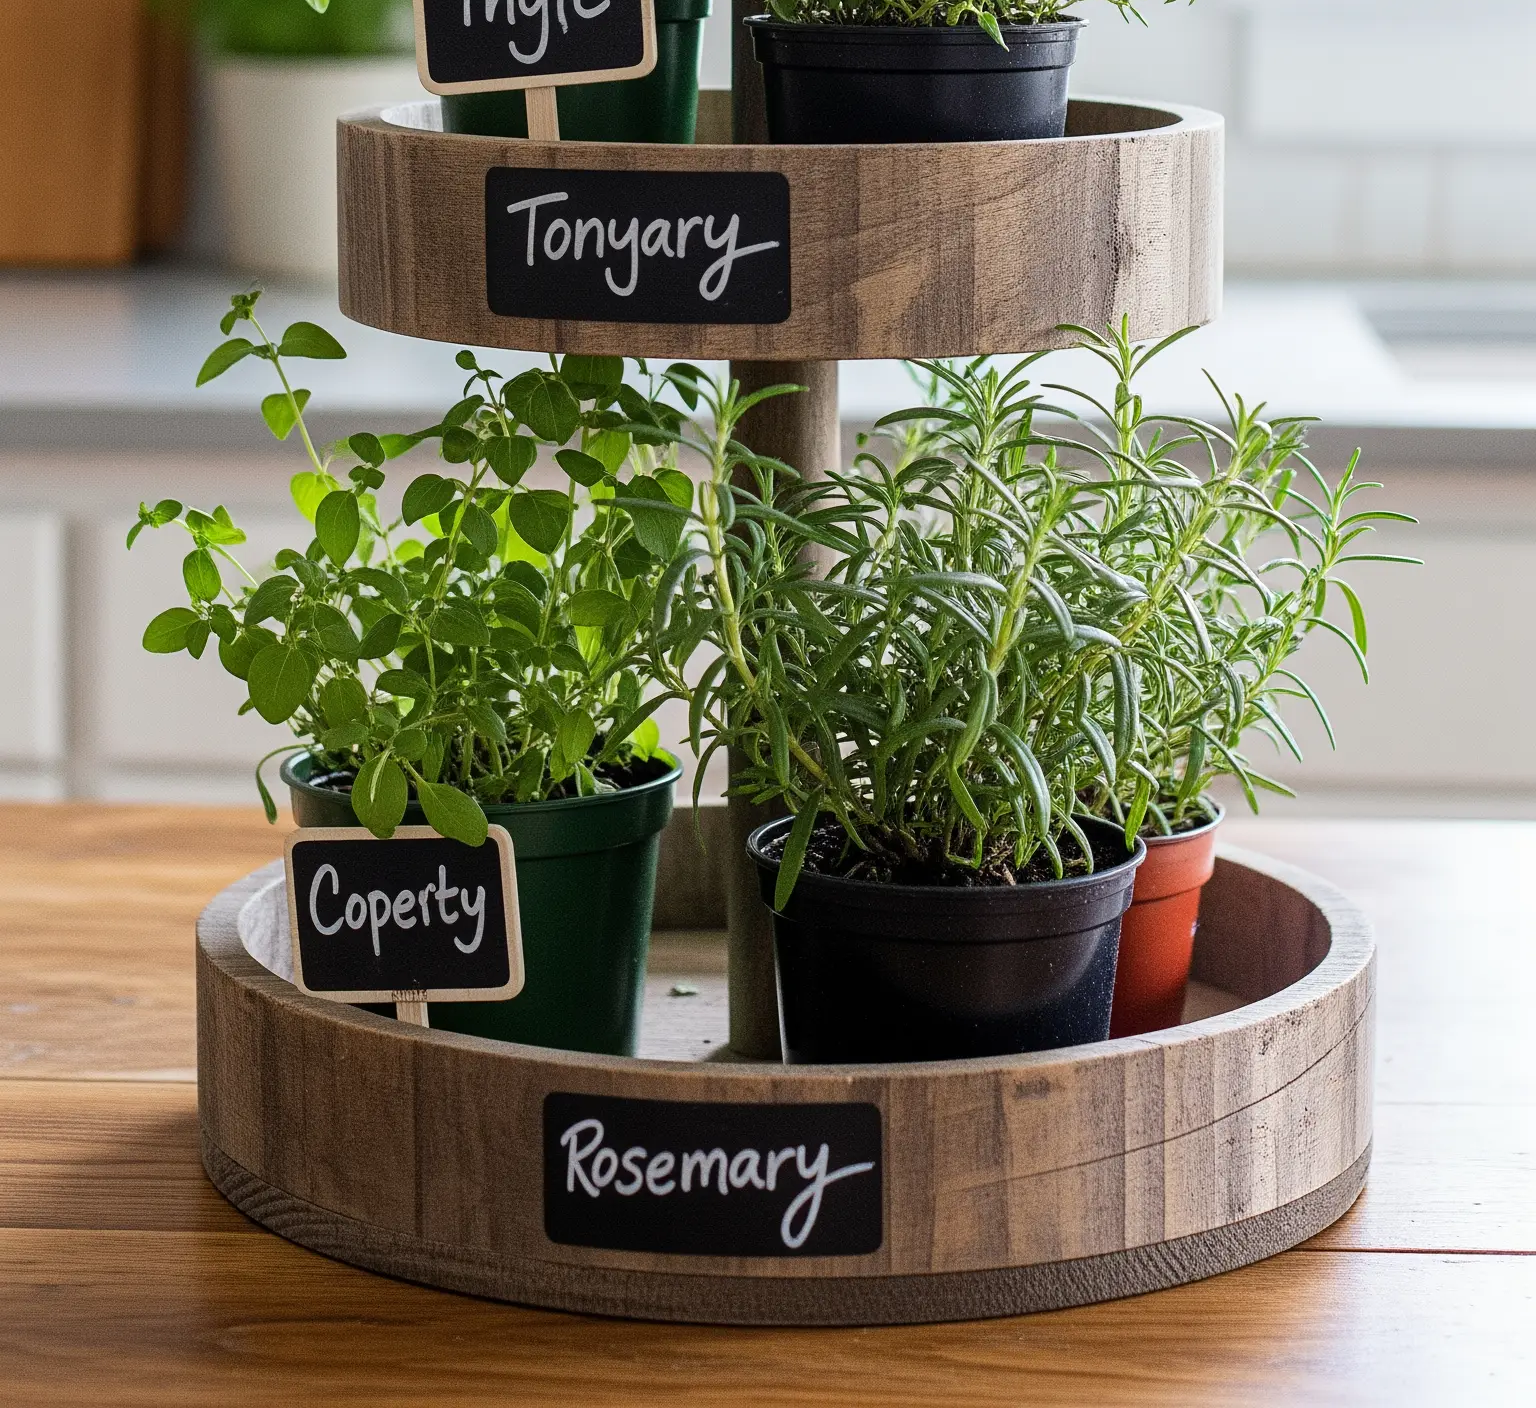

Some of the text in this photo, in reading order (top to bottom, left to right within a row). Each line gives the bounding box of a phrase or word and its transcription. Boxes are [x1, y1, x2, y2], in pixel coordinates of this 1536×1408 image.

[506, 191, 780, 301] Tonyary
[309, 863, 486, 957] Coperty
[560, 1118, 876, 1249] Rosemary
